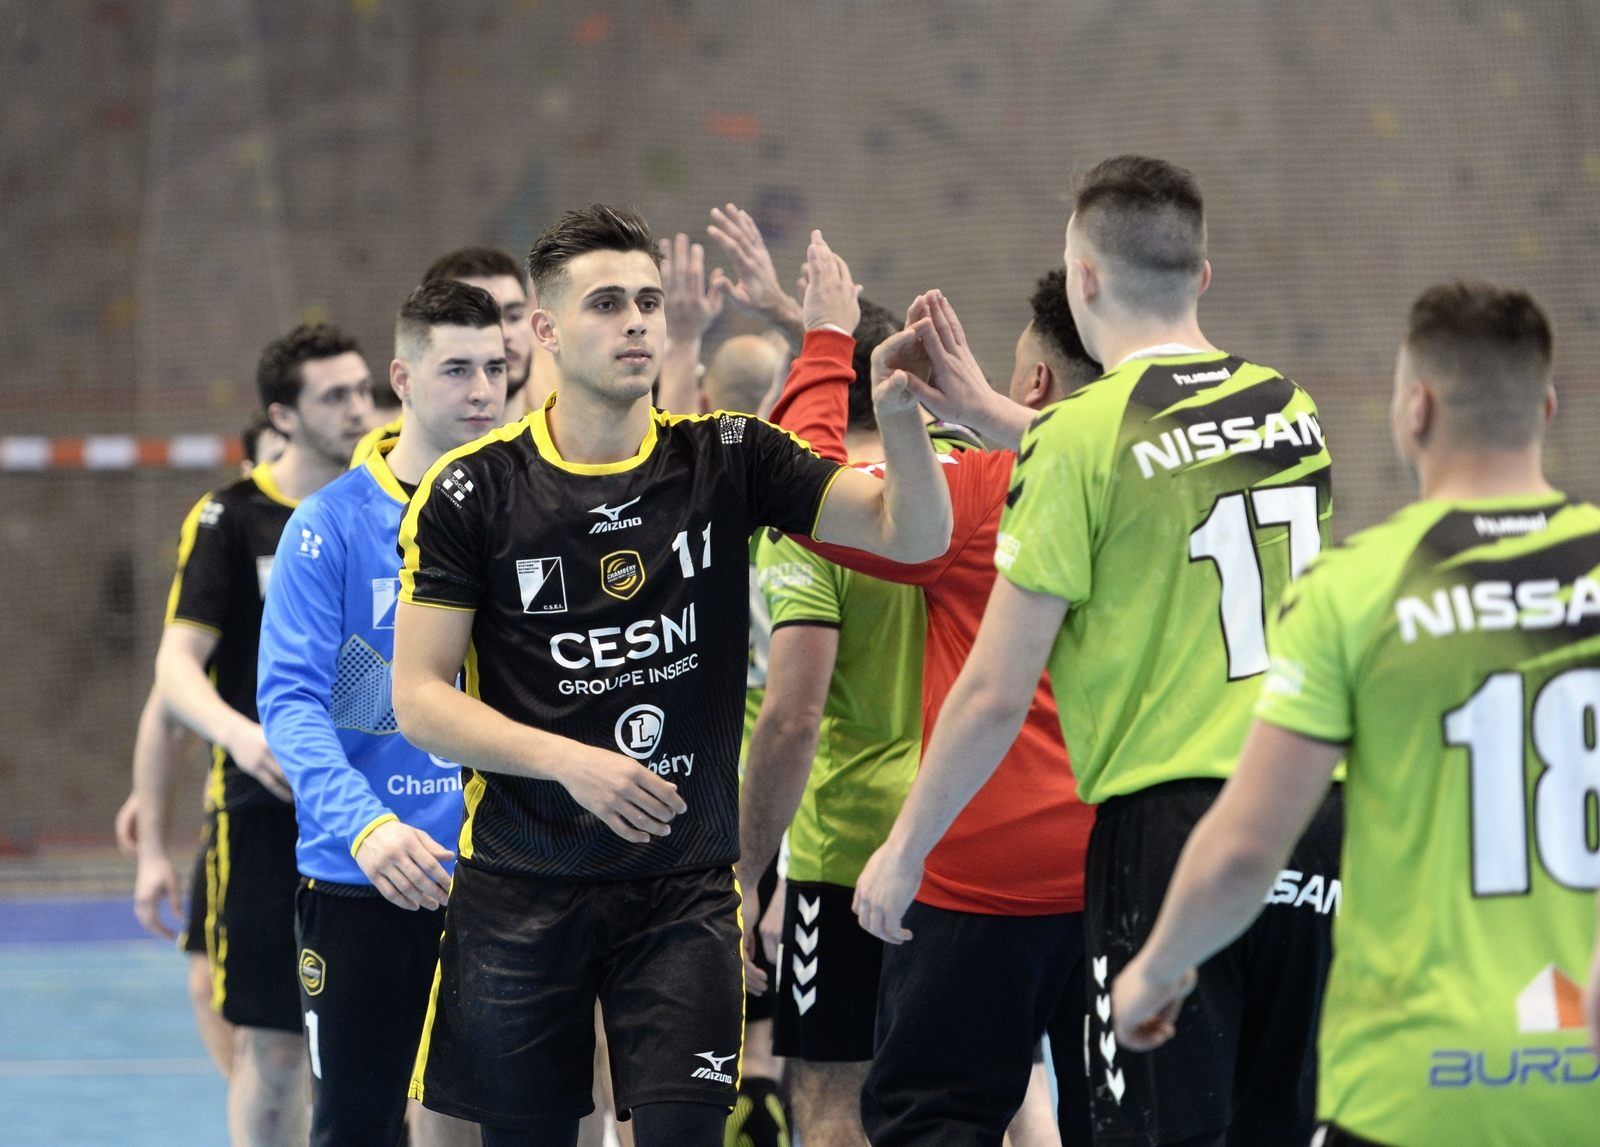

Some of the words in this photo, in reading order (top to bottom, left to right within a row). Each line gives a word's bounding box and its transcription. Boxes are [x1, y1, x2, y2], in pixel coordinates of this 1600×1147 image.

[1172, 366, 1231, 386] hummel
[1131, 411, 1325, 479] NISSAN
[671, 521, 711, 579] 11
[1189, 484, 1321, 682] 17
[550, 602, 696, 669] CESNI
[1395, 576, 1600, 644] NISSA
[558, 670, 645, 695] GROUPE
[649, 653, 698, 683] INSEEC
[1442, 667, 1600, 898] 18
[305, 1009, 322, 1079] 1
[1430, 1047, 1600, 1088] BURD
